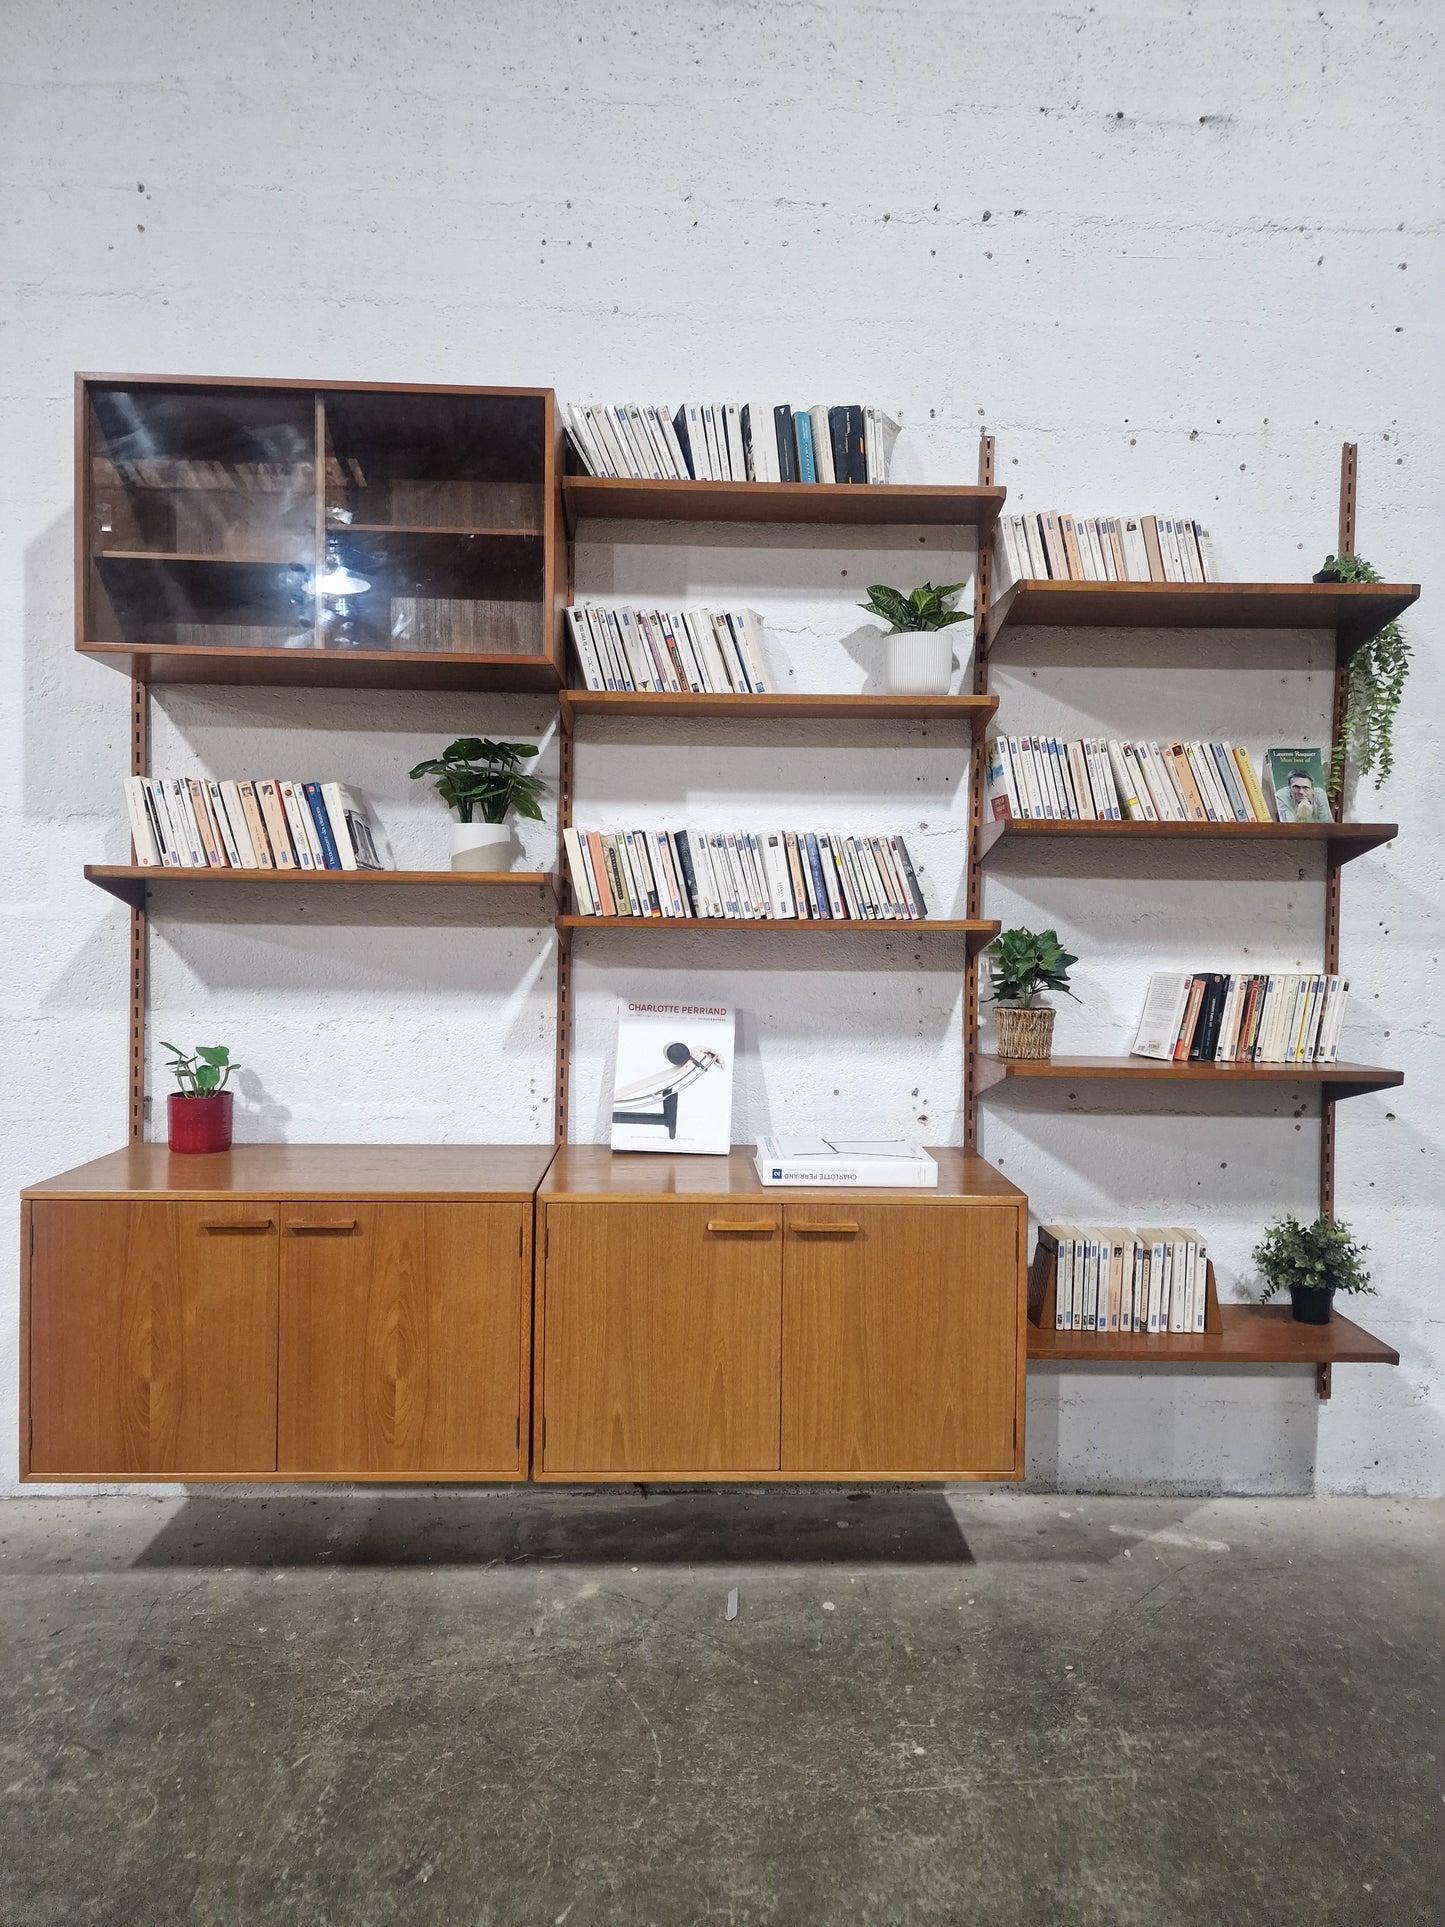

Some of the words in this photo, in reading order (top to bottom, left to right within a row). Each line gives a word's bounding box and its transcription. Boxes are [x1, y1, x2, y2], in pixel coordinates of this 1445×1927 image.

[628, 1003, 680, 1014] CHARLOTTE
[681, 1006, 727, 1016] PERRIAND
[819, 1173, 857, 1181] CHARLOTTE
